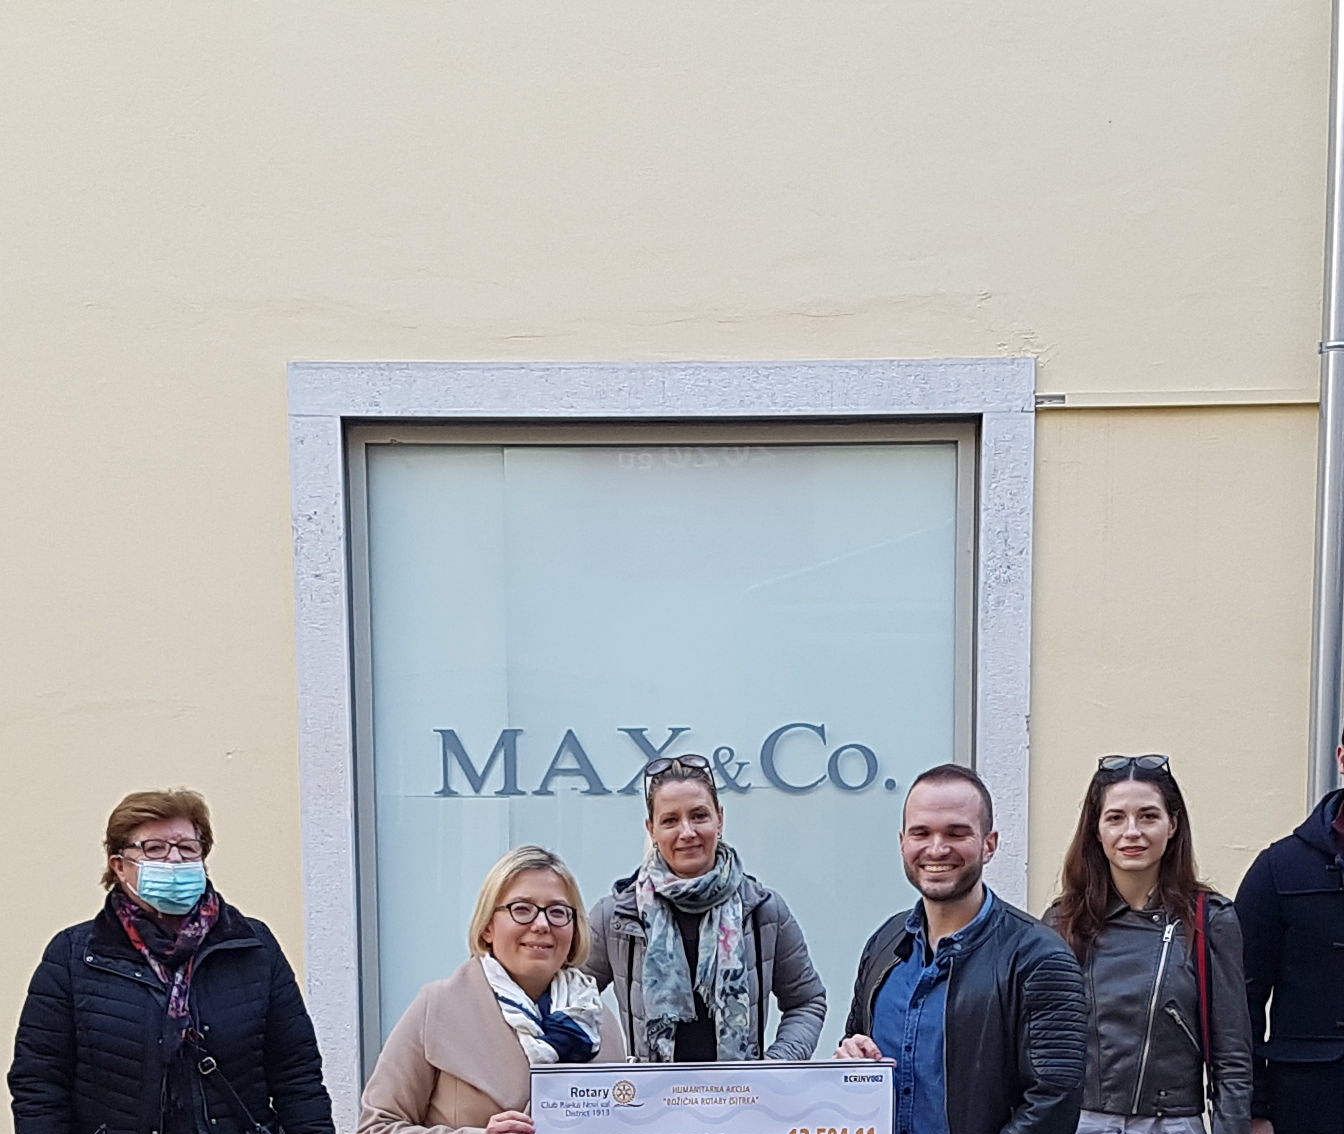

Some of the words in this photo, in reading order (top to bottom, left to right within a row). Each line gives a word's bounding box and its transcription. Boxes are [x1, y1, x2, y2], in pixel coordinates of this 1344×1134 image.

[570, 1087, 610, 1099] Rotary
[672, 1085, 724, 1094] HUMANITARNA
[725, 1085, 751, 1093] AKCIJA
[700, 1097, 727, 1105] ROTARY
[592, 1109, 611, 1117] 1913
